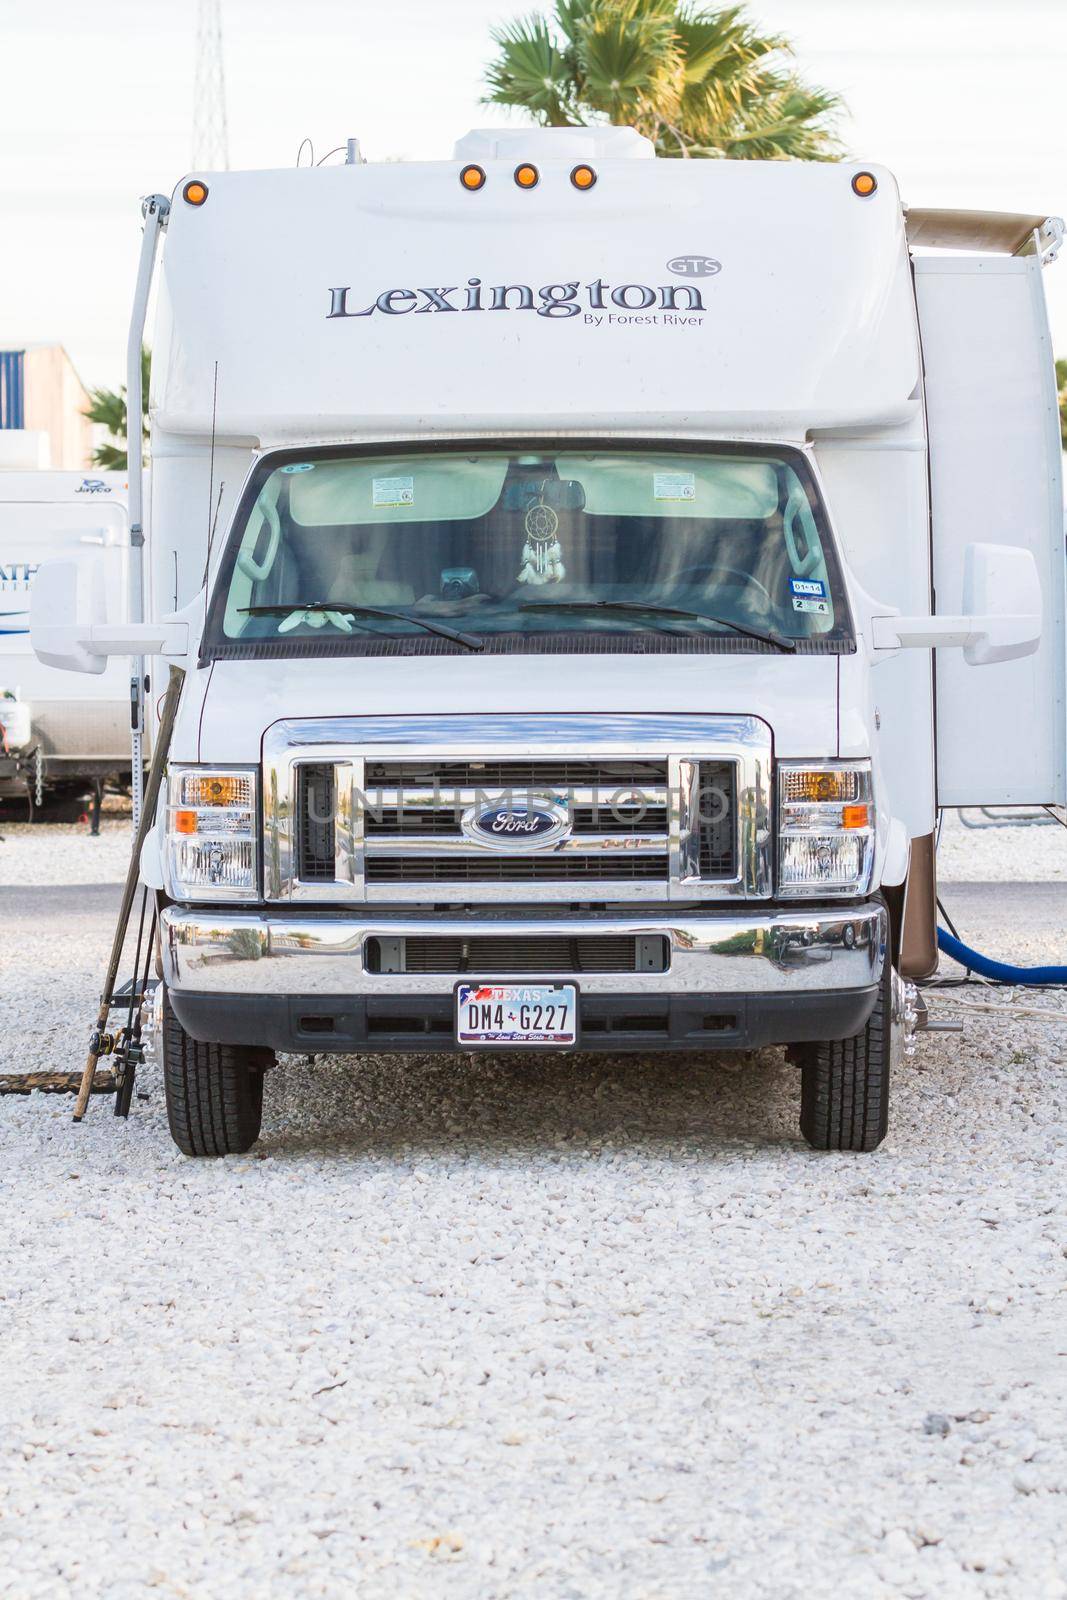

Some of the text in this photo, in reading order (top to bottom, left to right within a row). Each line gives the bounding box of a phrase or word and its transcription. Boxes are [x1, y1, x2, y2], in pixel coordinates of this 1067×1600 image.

[667, 259, 720, 274] GTS
[326, 278, 707, 319] Lexington
[584, 313, 703, 327] By Forest River
[492, 812, 539, 832] Ford
[491, 989, 542, 1002] TEXAS
[468, 1004, 568, 1030] DM4 G227
